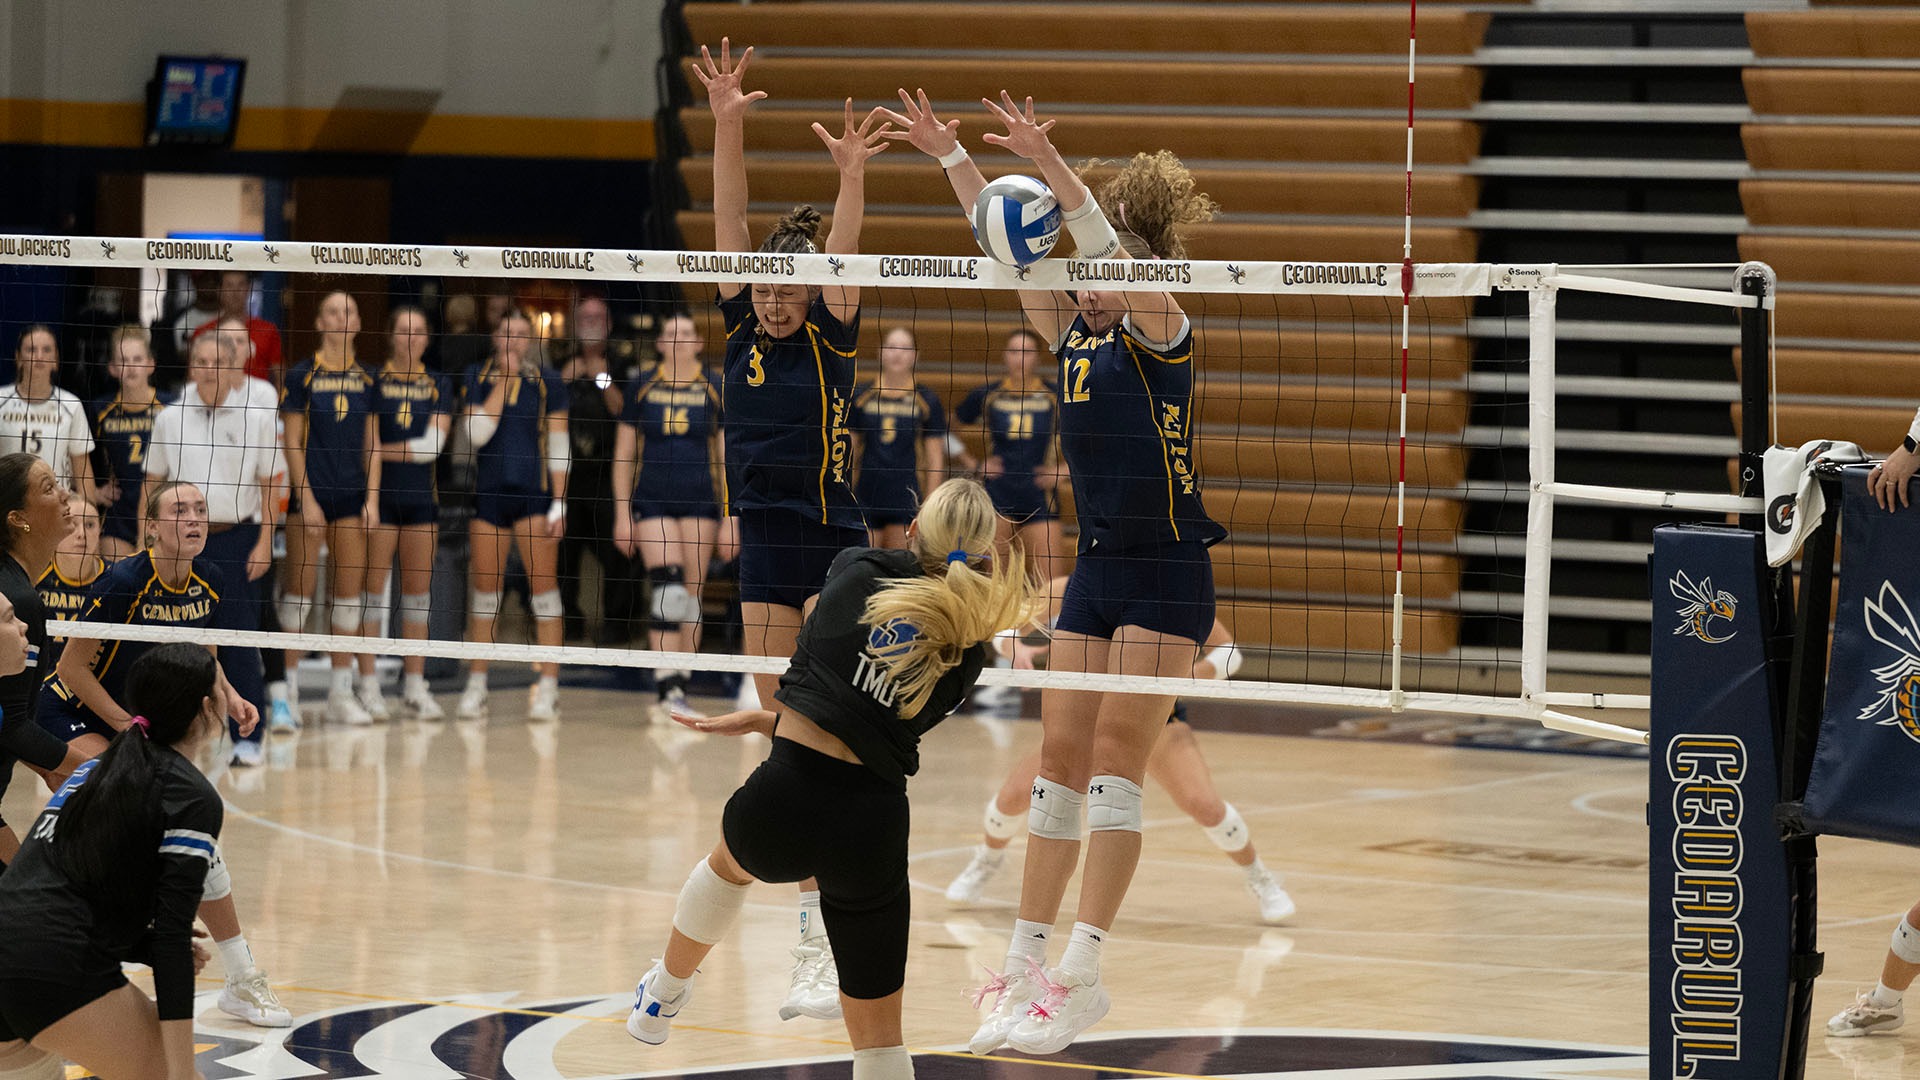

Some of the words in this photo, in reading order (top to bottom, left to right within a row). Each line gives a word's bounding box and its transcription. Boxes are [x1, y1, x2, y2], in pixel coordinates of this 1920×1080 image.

[146, 240, 234, 263] CEDARVILLE
[501, 249, 595, 272] CEDARVILLE
[879, 257, 978, 281] CEDARVILLE
[1281, 264, 1388, 286] CEDARVILLE
[1515, 268, 1540, 276] Senoh
[747, 344, 766, 387] 3
[1063, 357, 1091, 404] 12
[21, 429, 42, 454] 15
[129, 434, 143, 464] 2
[142, 599, 211, 622] CEDARVILLE
[852, 652, 900, 708] TMU
